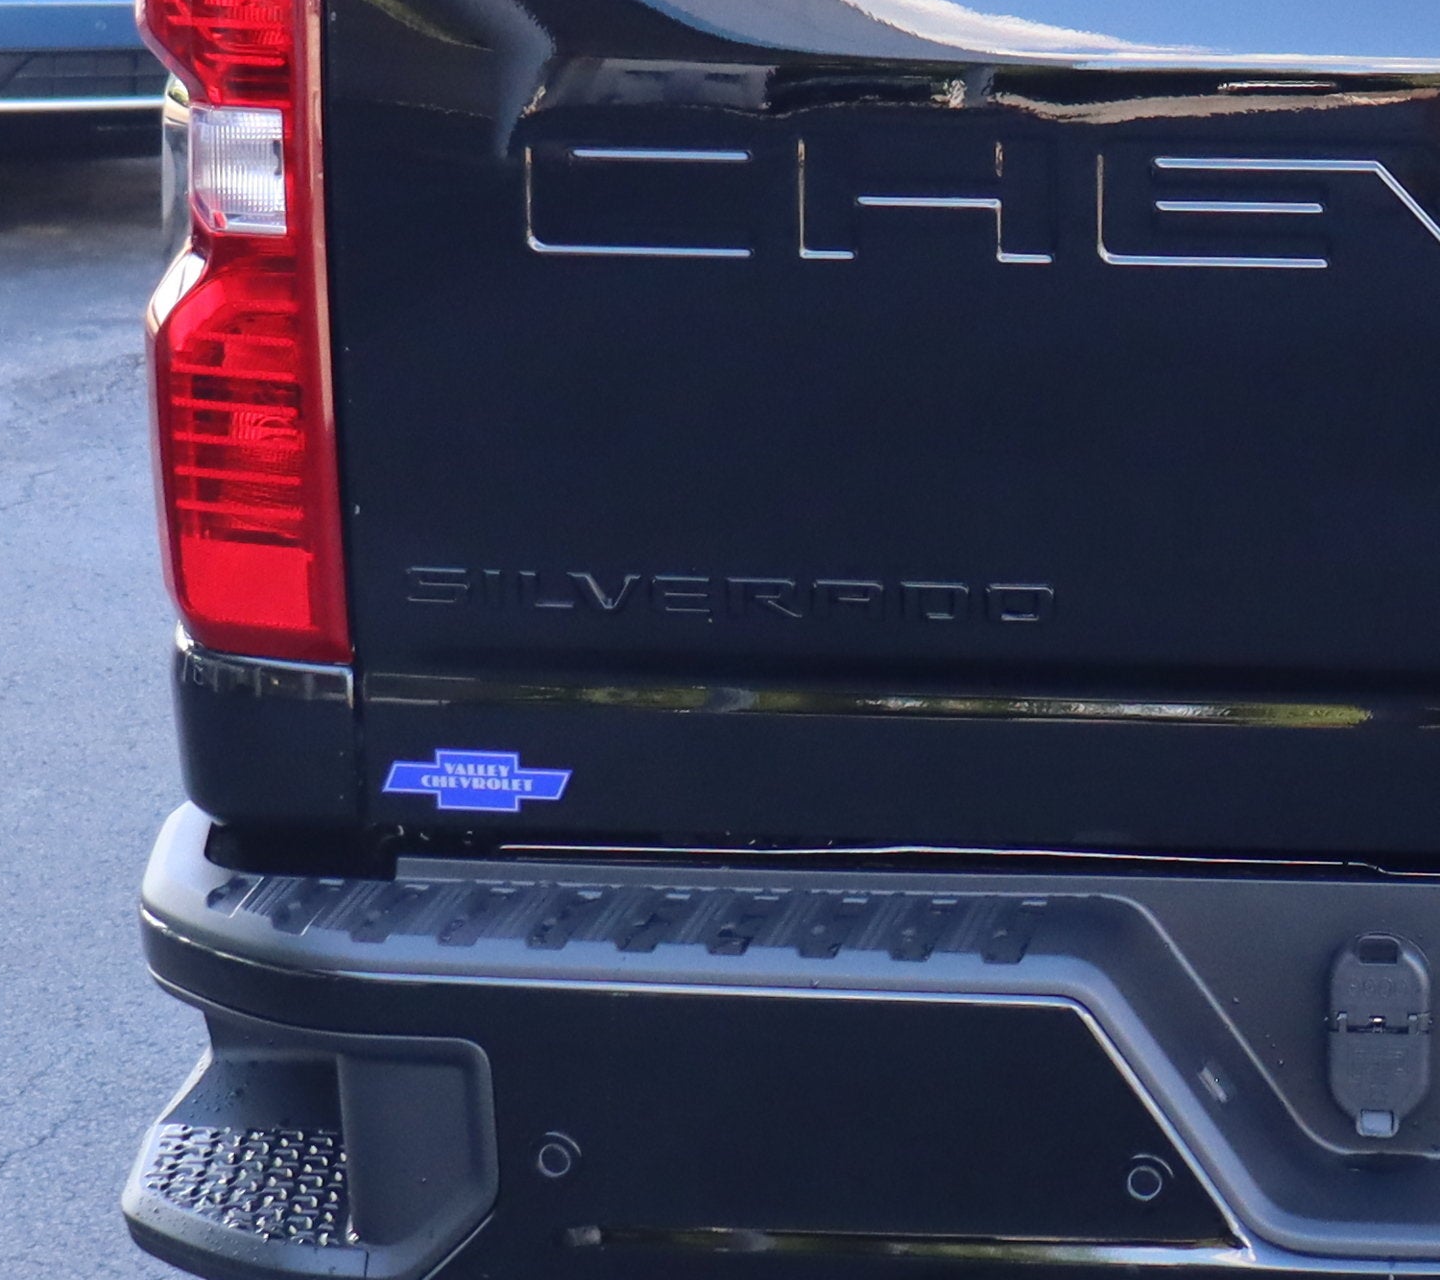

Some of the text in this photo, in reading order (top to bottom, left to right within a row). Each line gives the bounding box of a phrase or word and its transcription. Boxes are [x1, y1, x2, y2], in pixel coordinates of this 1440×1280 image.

[404, 564, 1056, 624] SILVERADO
[444, 763, 510, 778] VALLEY
[420, 774, 534, 792] CHEVROLET
